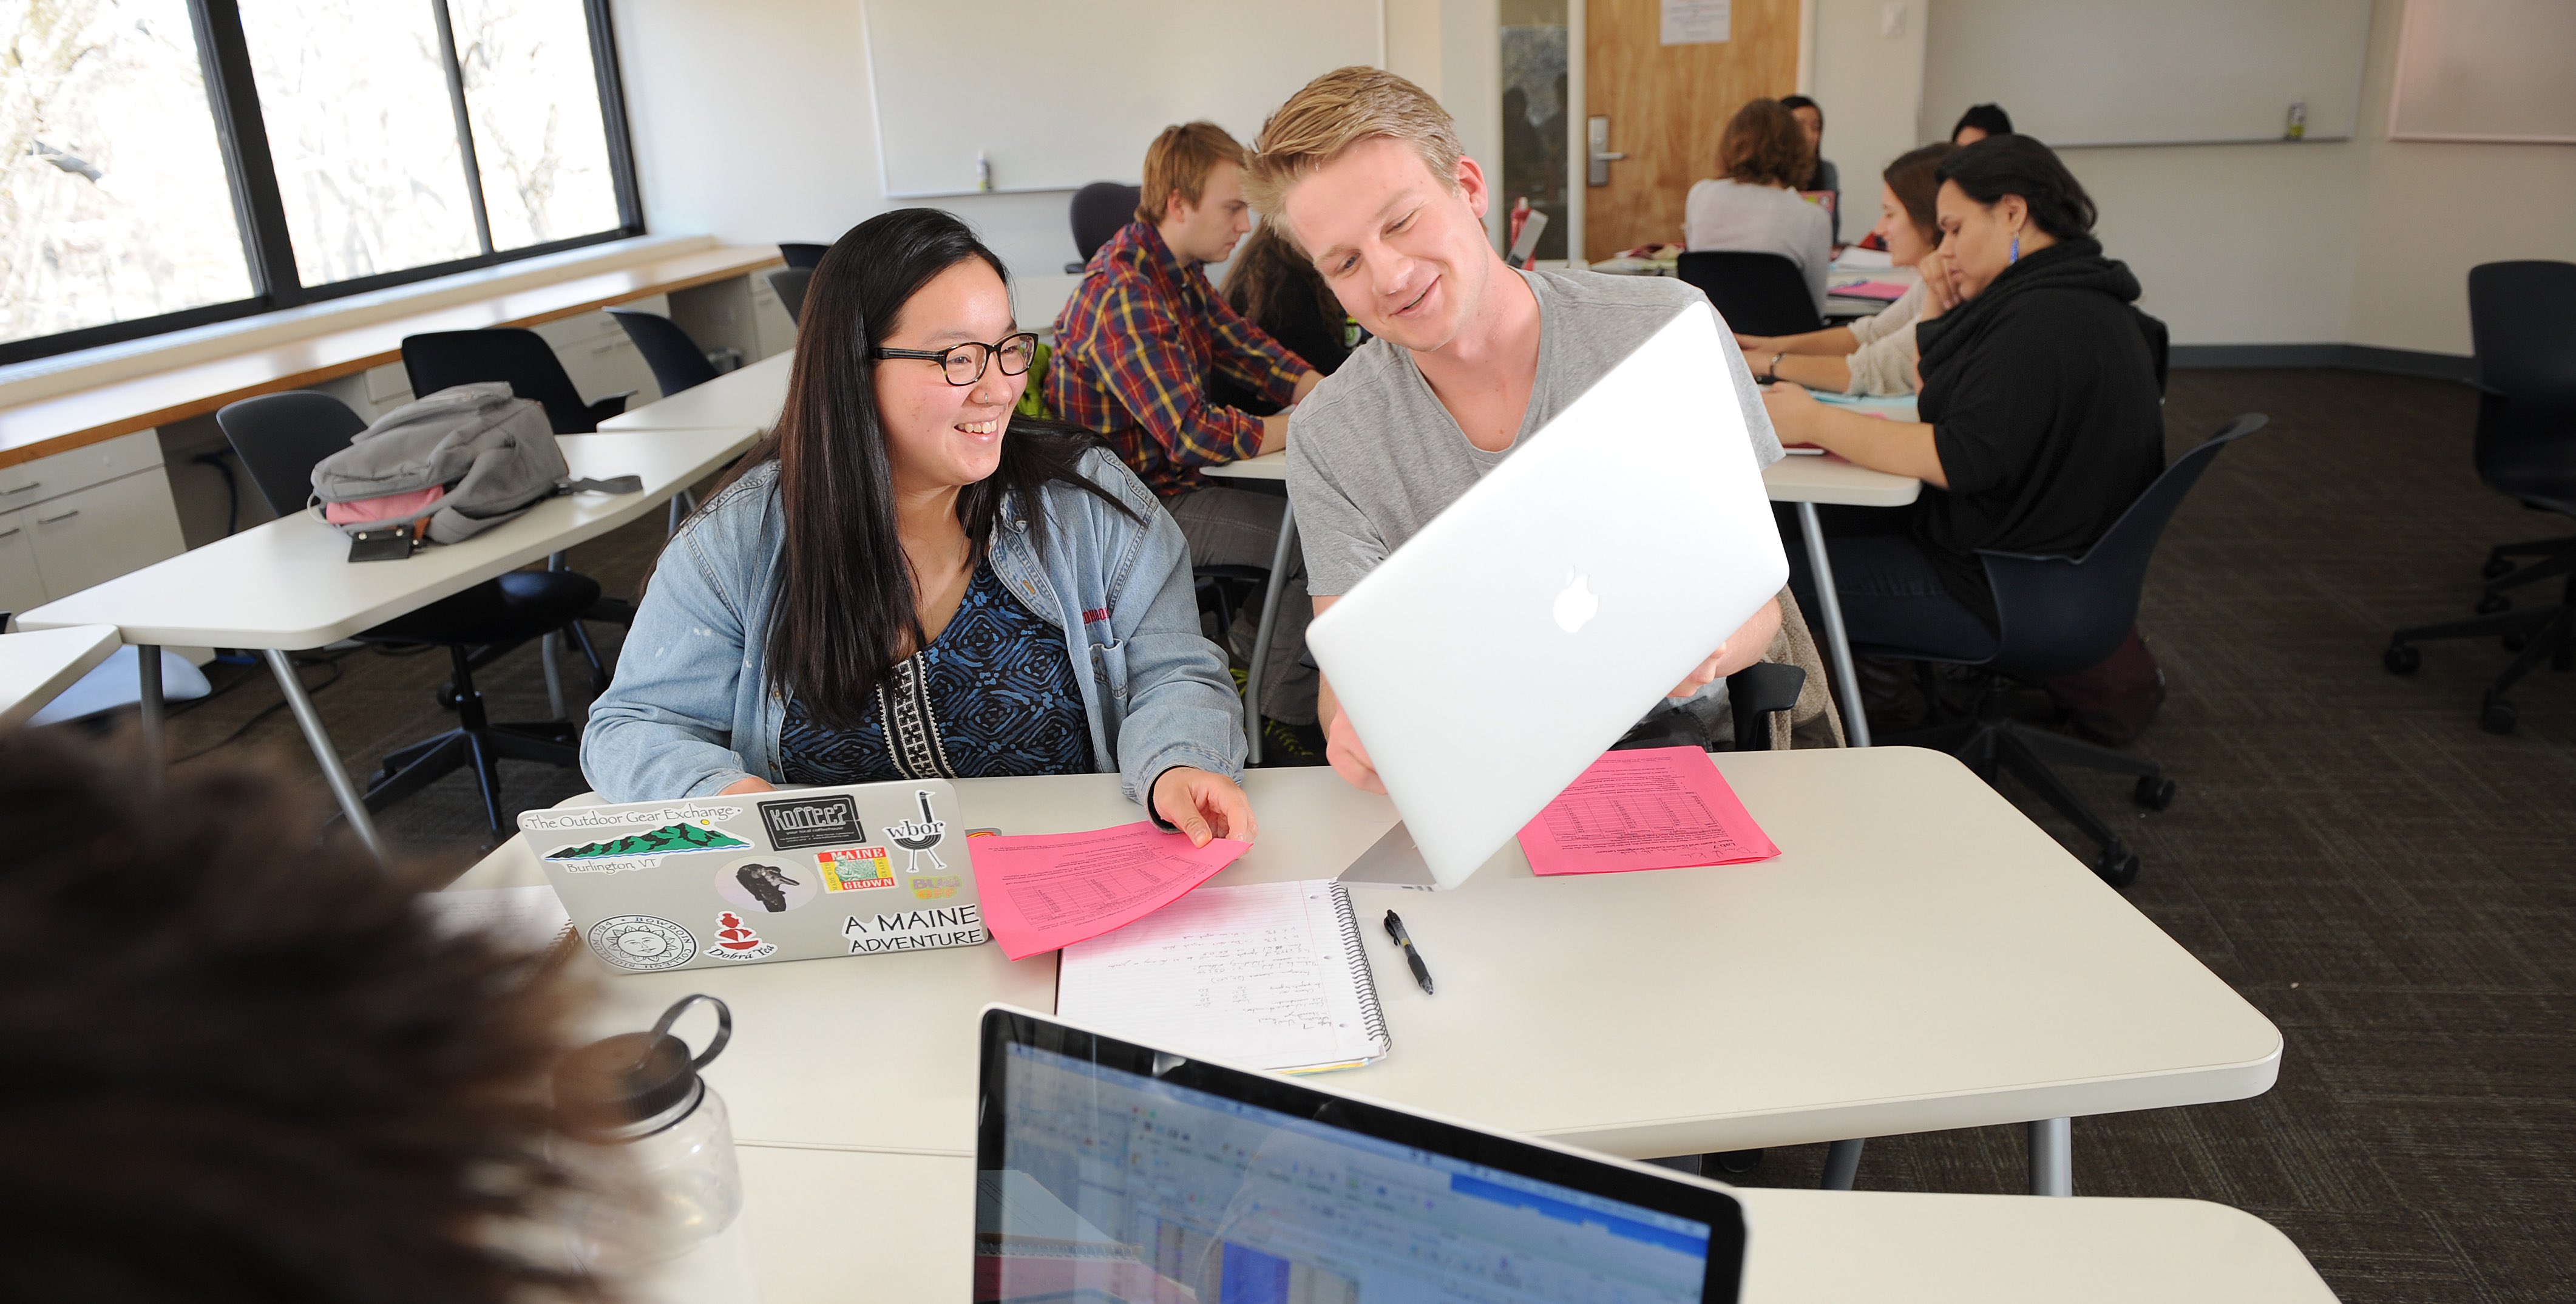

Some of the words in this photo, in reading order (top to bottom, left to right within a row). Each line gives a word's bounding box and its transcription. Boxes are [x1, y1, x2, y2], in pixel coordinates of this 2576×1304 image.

[527, 817, 556, 829] The
[560, 810, 626, 828] Outdoor
[626, 812, 660, 823] Gear
[665, 804, 733, 820] Exchange
[770, 804, 847, 830] Koffee?
[886, 821, 944, 838] wbor
[831, 848, 883, 861] MAINE
[567, 861, 636, 874] Burlington,
[638, 858, 656, 868] VT
[844, 878, 893, 889] GROWN
[913, 878, 960, 889] BUG
[918, 887, 954, 899] OFF
[846, 917, 867, 934] A
[877, 905, 979, 931] MAINE
[593, 921, 613, 936] 1794
[636, 917, 691, 943] BOWDOIN
[851, 929, 983, 953] ADVENTURE
[708, 948, 753, 960] Dobrá
[753, 945, 775, 957] Tea
